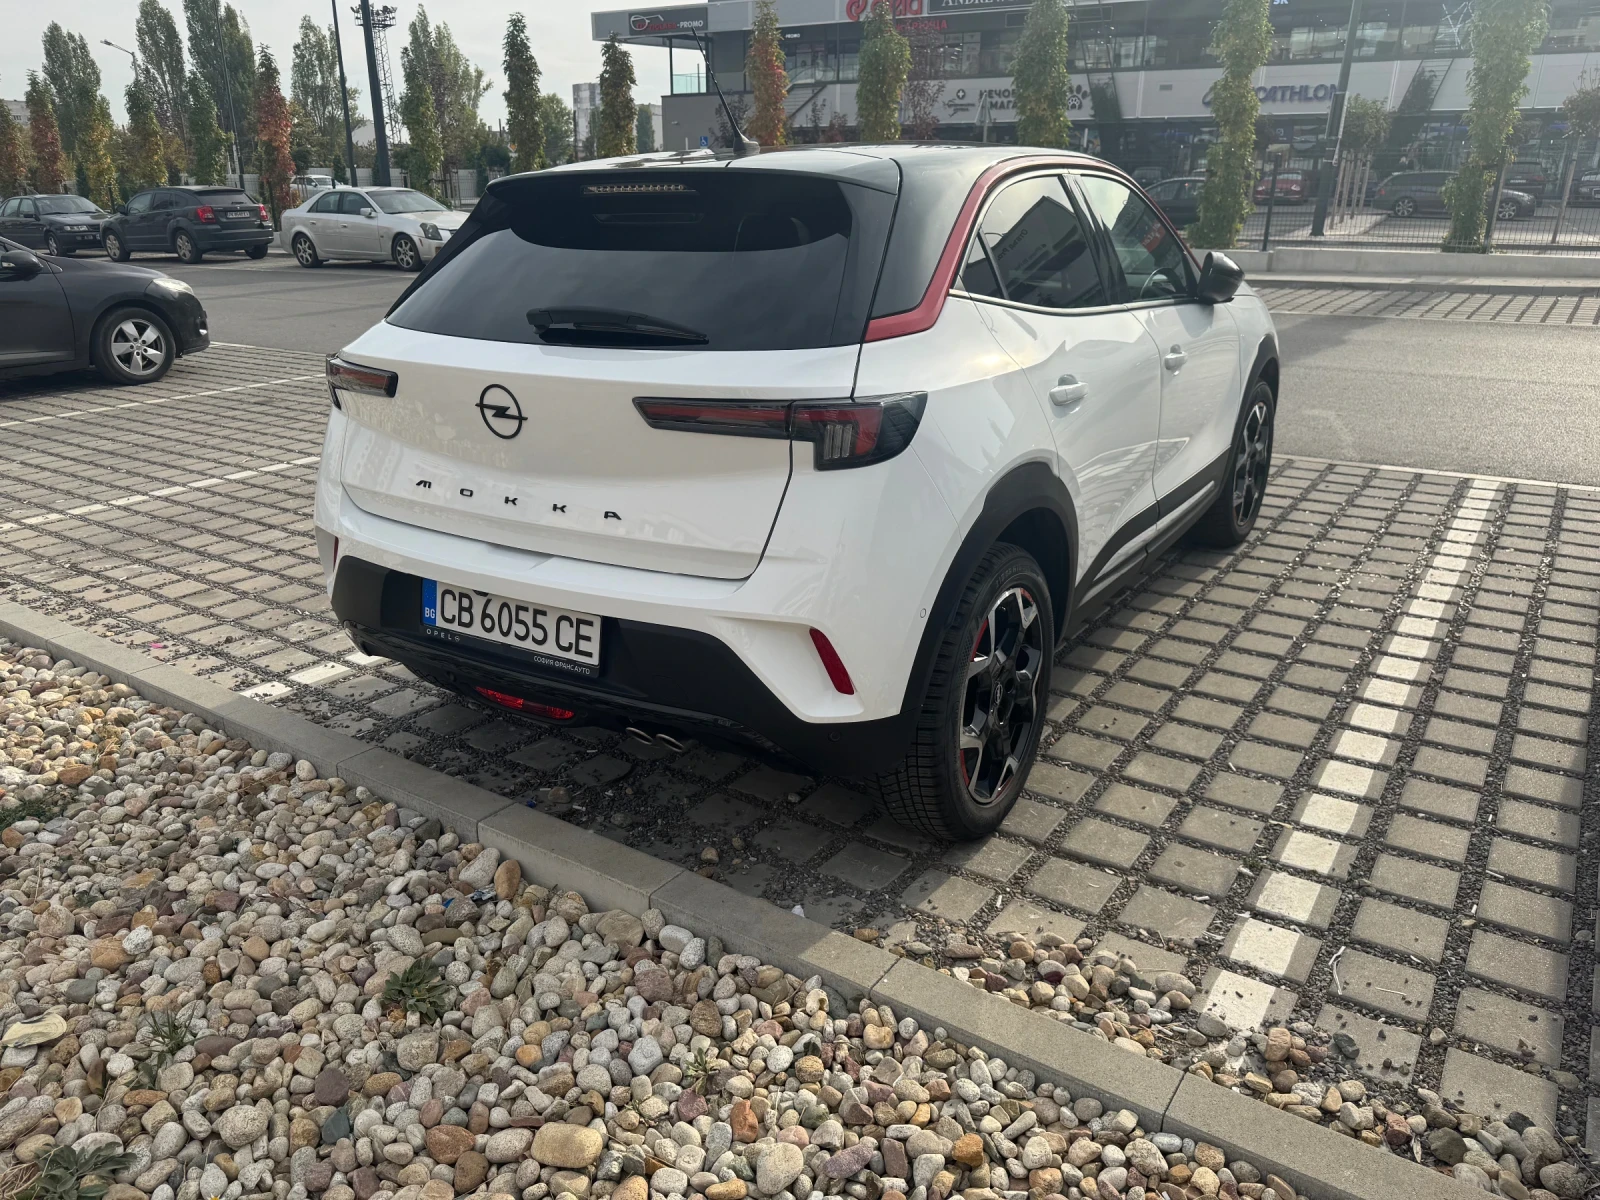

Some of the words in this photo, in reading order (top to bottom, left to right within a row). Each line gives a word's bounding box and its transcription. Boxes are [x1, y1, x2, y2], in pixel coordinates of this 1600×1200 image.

[1255, 83, 1338, 103] CATHLON
[415, 479, 622, 520] MOKKA
[424, 607, 436, 619] BG
[440, 588, 474, 628] CB
[480, 598, 548, 646] 6055
[555, 615, 594, 658] CE
[426, 628, 452, 640] OPEL
[533, 655, 554, 667] СОФИЯ
